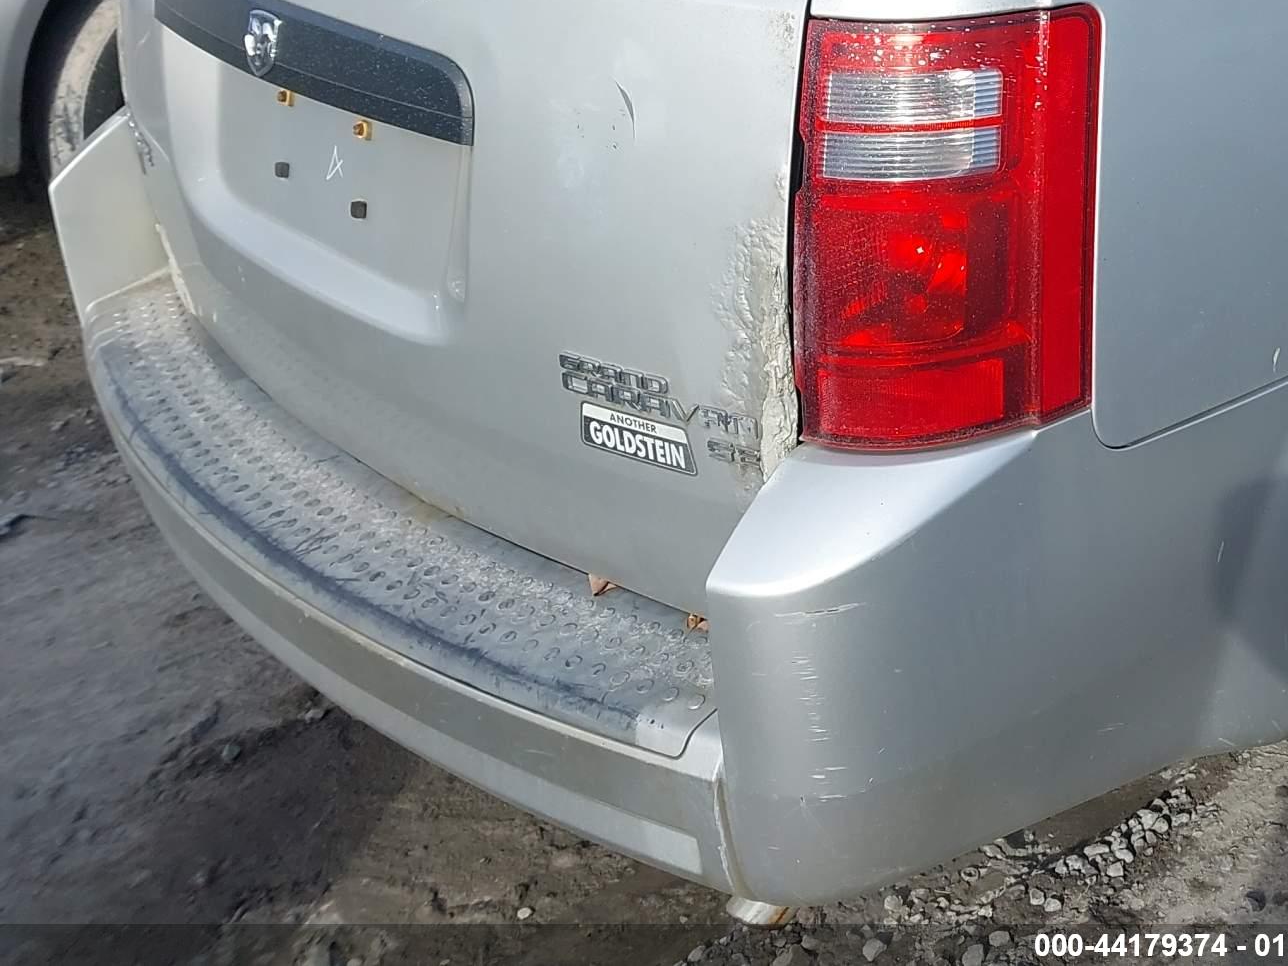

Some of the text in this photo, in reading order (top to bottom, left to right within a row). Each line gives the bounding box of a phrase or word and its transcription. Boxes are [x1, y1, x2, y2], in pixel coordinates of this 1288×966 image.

[558, 351, 669, 395] GRAND
[561, 371, 759, 439] CARAVAN
[609, 412, 658, 434] ANOTHER
[589, 420, 687, 469] GOLDSTEIN
